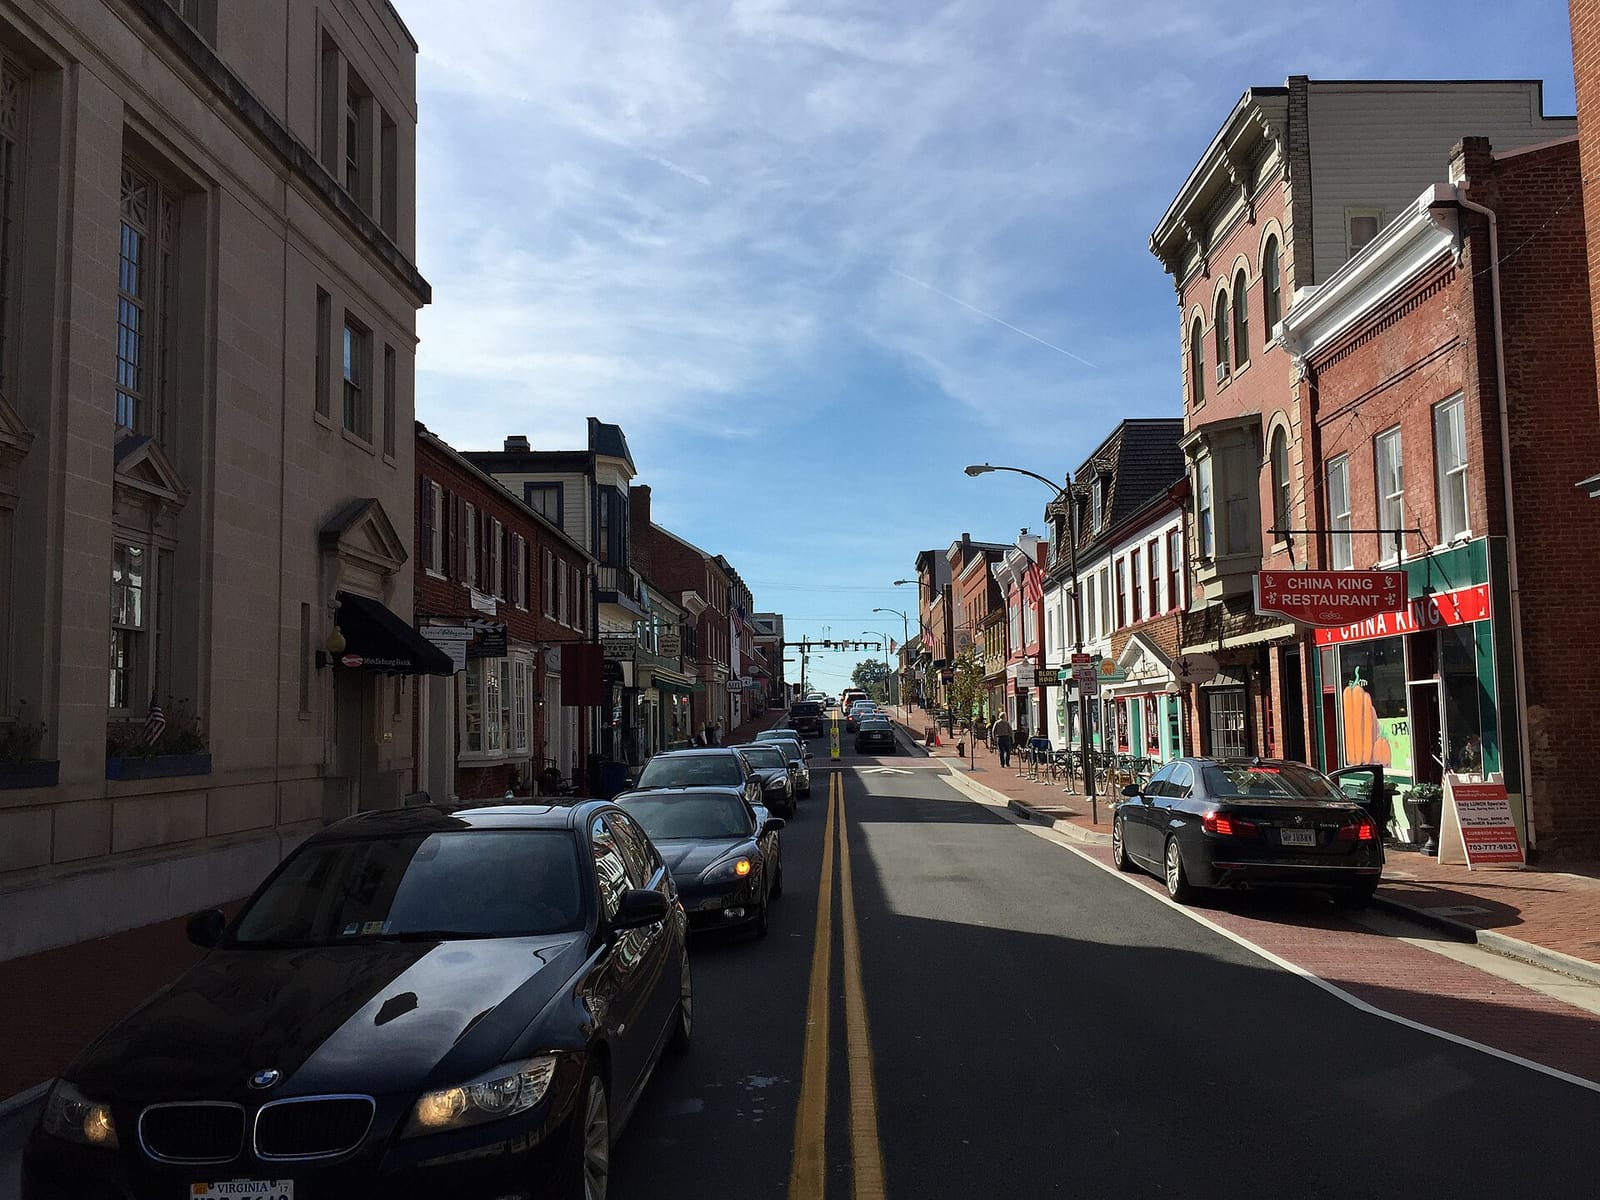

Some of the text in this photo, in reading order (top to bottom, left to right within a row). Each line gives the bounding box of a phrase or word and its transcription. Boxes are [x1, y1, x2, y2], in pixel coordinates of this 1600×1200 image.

[1287, 577, 1373, 590] CHINA KING
[1281, 594, 1380, 606] RESTAURANT
[1395, 598, 1440, 630] KING
[217, 1182, 268, 1193] VIRGINIA
